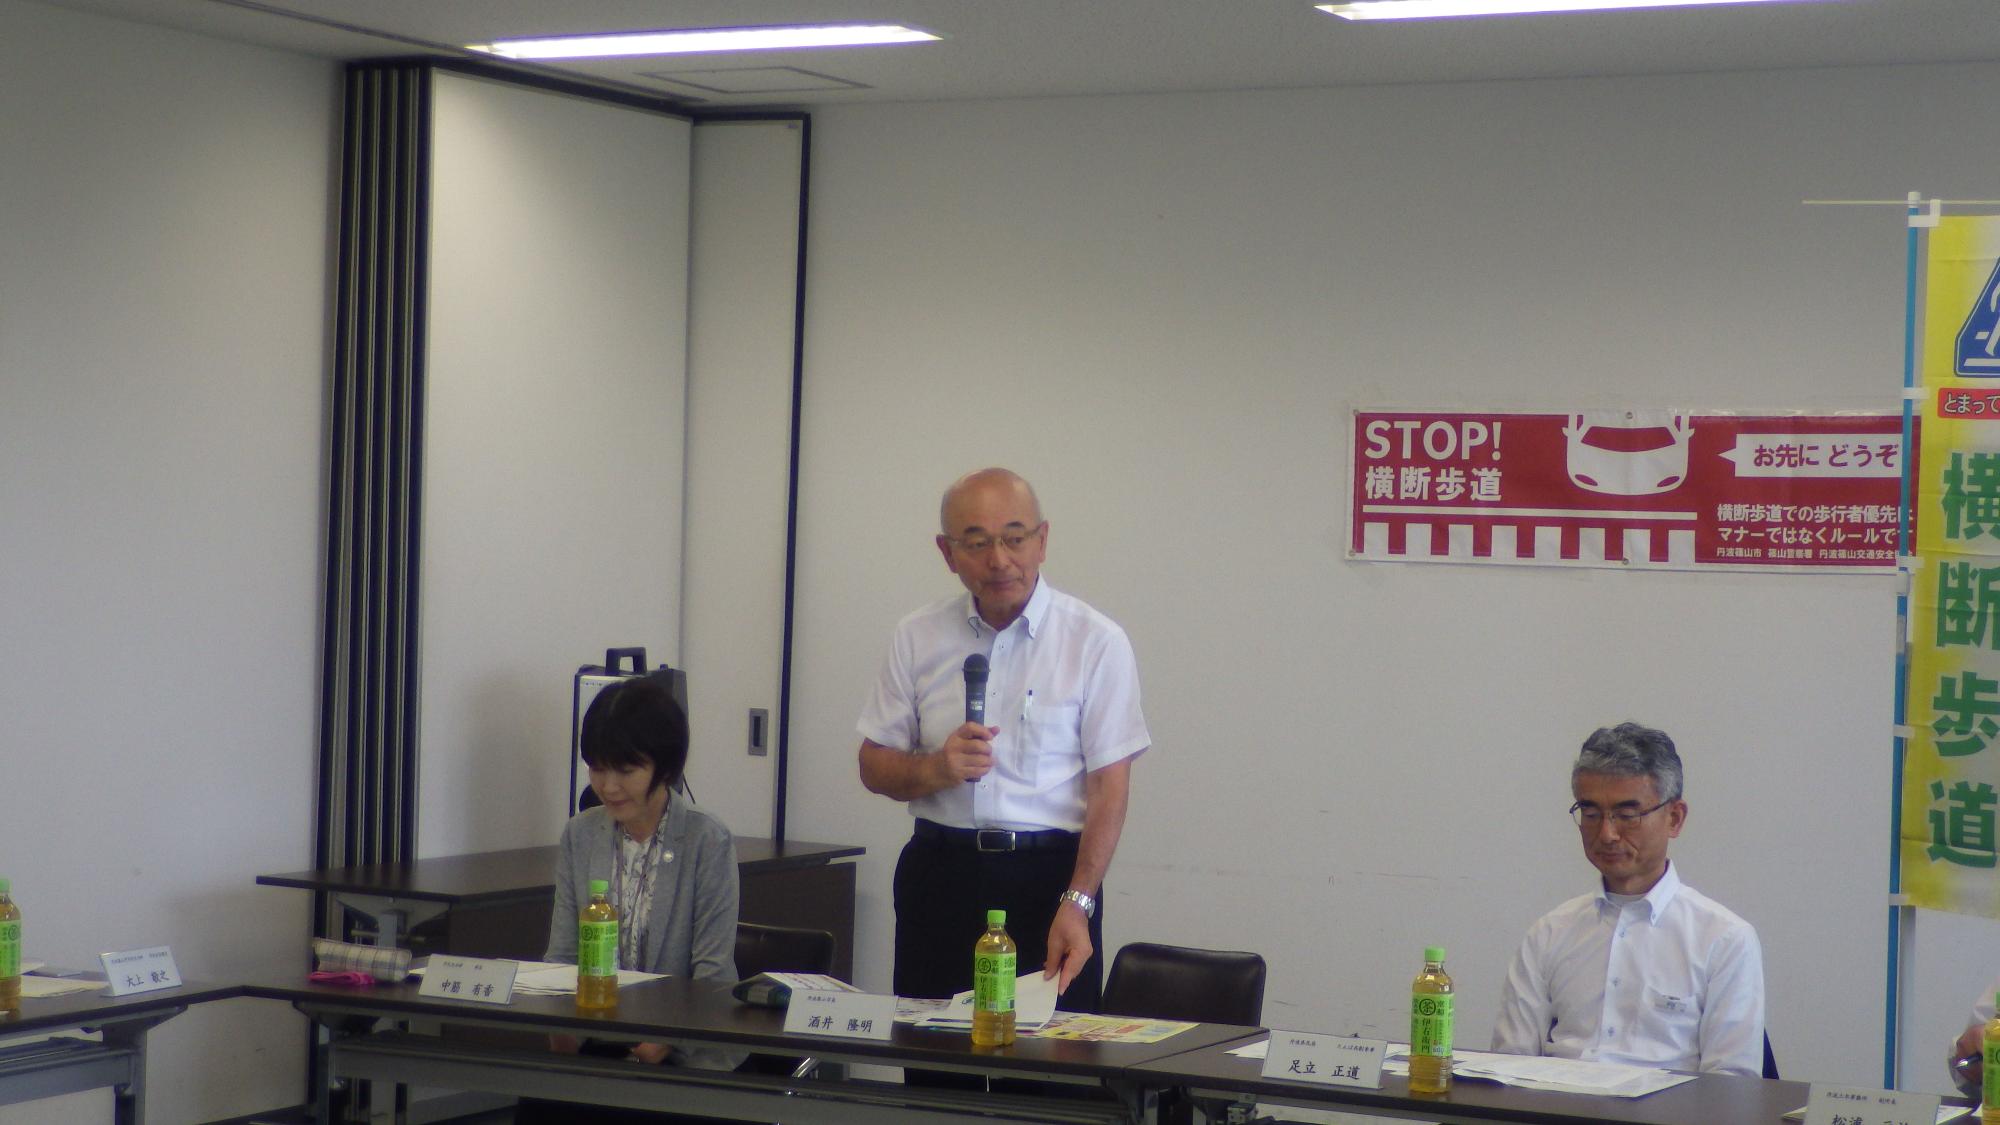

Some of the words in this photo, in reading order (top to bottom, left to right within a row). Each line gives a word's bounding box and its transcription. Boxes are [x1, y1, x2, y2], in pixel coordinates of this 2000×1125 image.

[1943, 393, 2000, 414] とまって
[1365, 420, 1502, 460] STOP!
[1753, 444, 1820, 468] お先に
[1828, 444, 1899, 468] どうぞ
[1365, 465, 1502, 501] 横断歩道
[1927, 453, 2000, 868] 横断歩道
[808, 1015, 834, 1030] 酒井
[847, 1018, 873, 1033] 隆明
[1288, 1059, 1317, 1074] 足立
[1331, 1065, 1361, 1080] 正道
